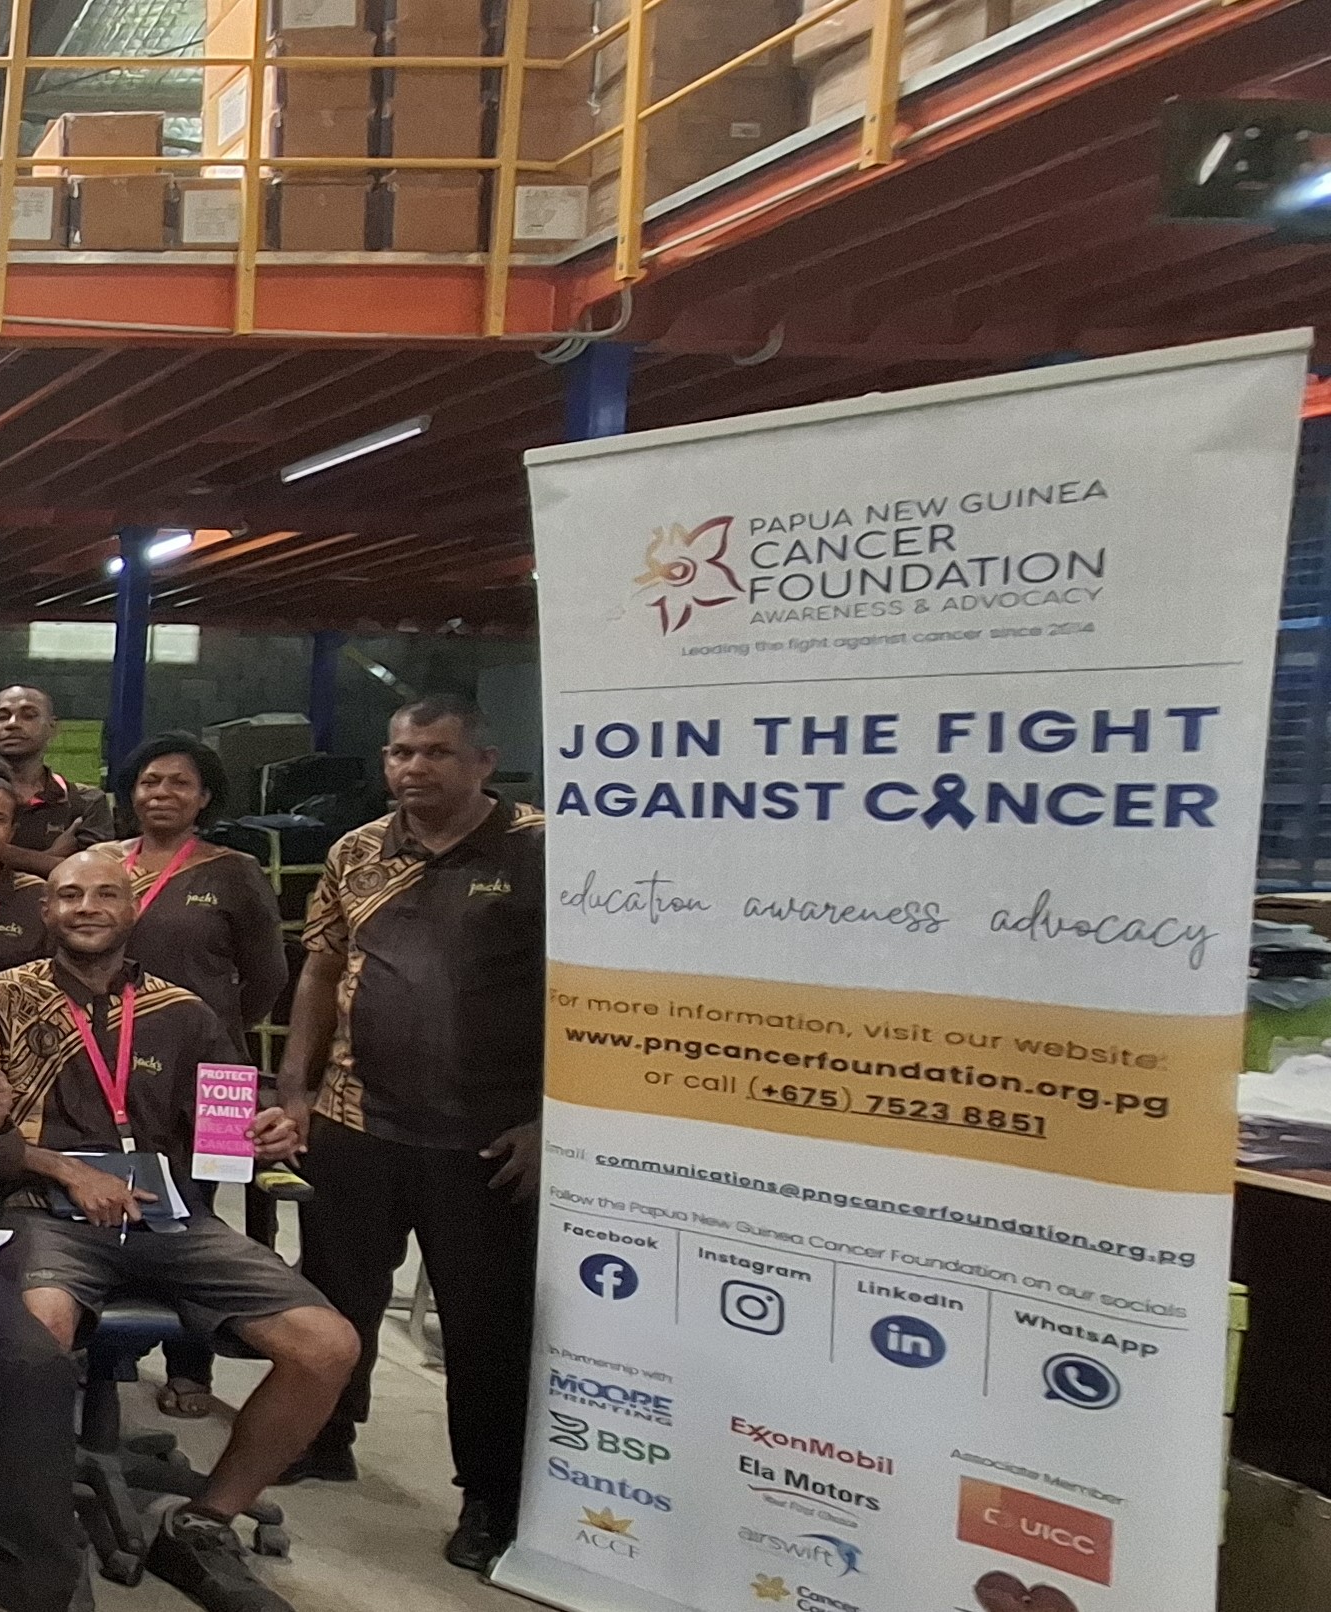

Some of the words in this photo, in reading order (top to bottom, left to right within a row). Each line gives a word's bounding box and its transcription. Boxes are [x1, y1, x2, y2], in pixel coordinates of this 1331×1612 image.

[749, 508, 854, 537] PAPUA
[865, 496, 948, 525] NEW
[960, 479, 1109, 515] GUINEA
[749, 523, 957, 570] CANCER
[748, 546, 1106, 605] FOUNDATION
[749, 600, 903, 625] AWARENESS
[913, 598, 930, 614] &
[941, 586, 1104, 612] ADVOCACY
[681, 640, 750, 658] Leading
[788, 635, 828, 653] fight
[832, 632, 907, 651] against
[912, 628, 982, 644] cancer
[560, 717, 722, 761] JOIN
[753, 713, 900, 757] THE
[937, 705, 1222, 754] FIGHT
[555, 780, 845, 822] AGAINST
[558, 870, 712, 925] education
[743, 893, 951, 935] awareness
[989, 889, 1219, 969] advocacy
[588, 996, 659, 1016] more
[669, 1001, 853, 1039] information,
[864, 1020, 932, 1043] visit
[944, 1031, 1002, 1050] our
[200, 1069, 255, 1082] PROTECT
[201, 1083, 254, 1101] YOUR
[565, 1027, 1169, 1119] www.pngcancerfoundation.org.pg
[199, 1104, 253, 1119] FAMILY
[644, 1070, 674, 1086] or
[683, 1075, 736, 1094] call
[748, 1075, 852, 1113] (+675)
[865, 1094, 951, 1122] 7523
[962, 1106, 1046, 1137] 8851
[595, 1153, 1196, 1268] communications@pngcancerfoundation.org.pg
[563, 1222, 660, 1250] Facebook
[698, 1247, 812, 1283] Instagram
[808, 1235, 886, 1259] Cancer
[890, 1249, 1017, 1284] Foundation
[1022, 1274, 1052, 1291] on
[857, 1280, 965, 1312] LinkedIn
[1014, 1309, 1160, 1358] WhatsApp
[548, 1387, 674, 1427] PRINTING
[549, 1368, 674, 1418] MOORE
[596, 1429, 672, 1465] BSP
[730, 1415, 895, 1476] ExxonMobil
[548, 1455, 673, 1513] Santos
[739, 1454, 775, 1482] Ela
[784, 1468, 881, 1512] Motors
